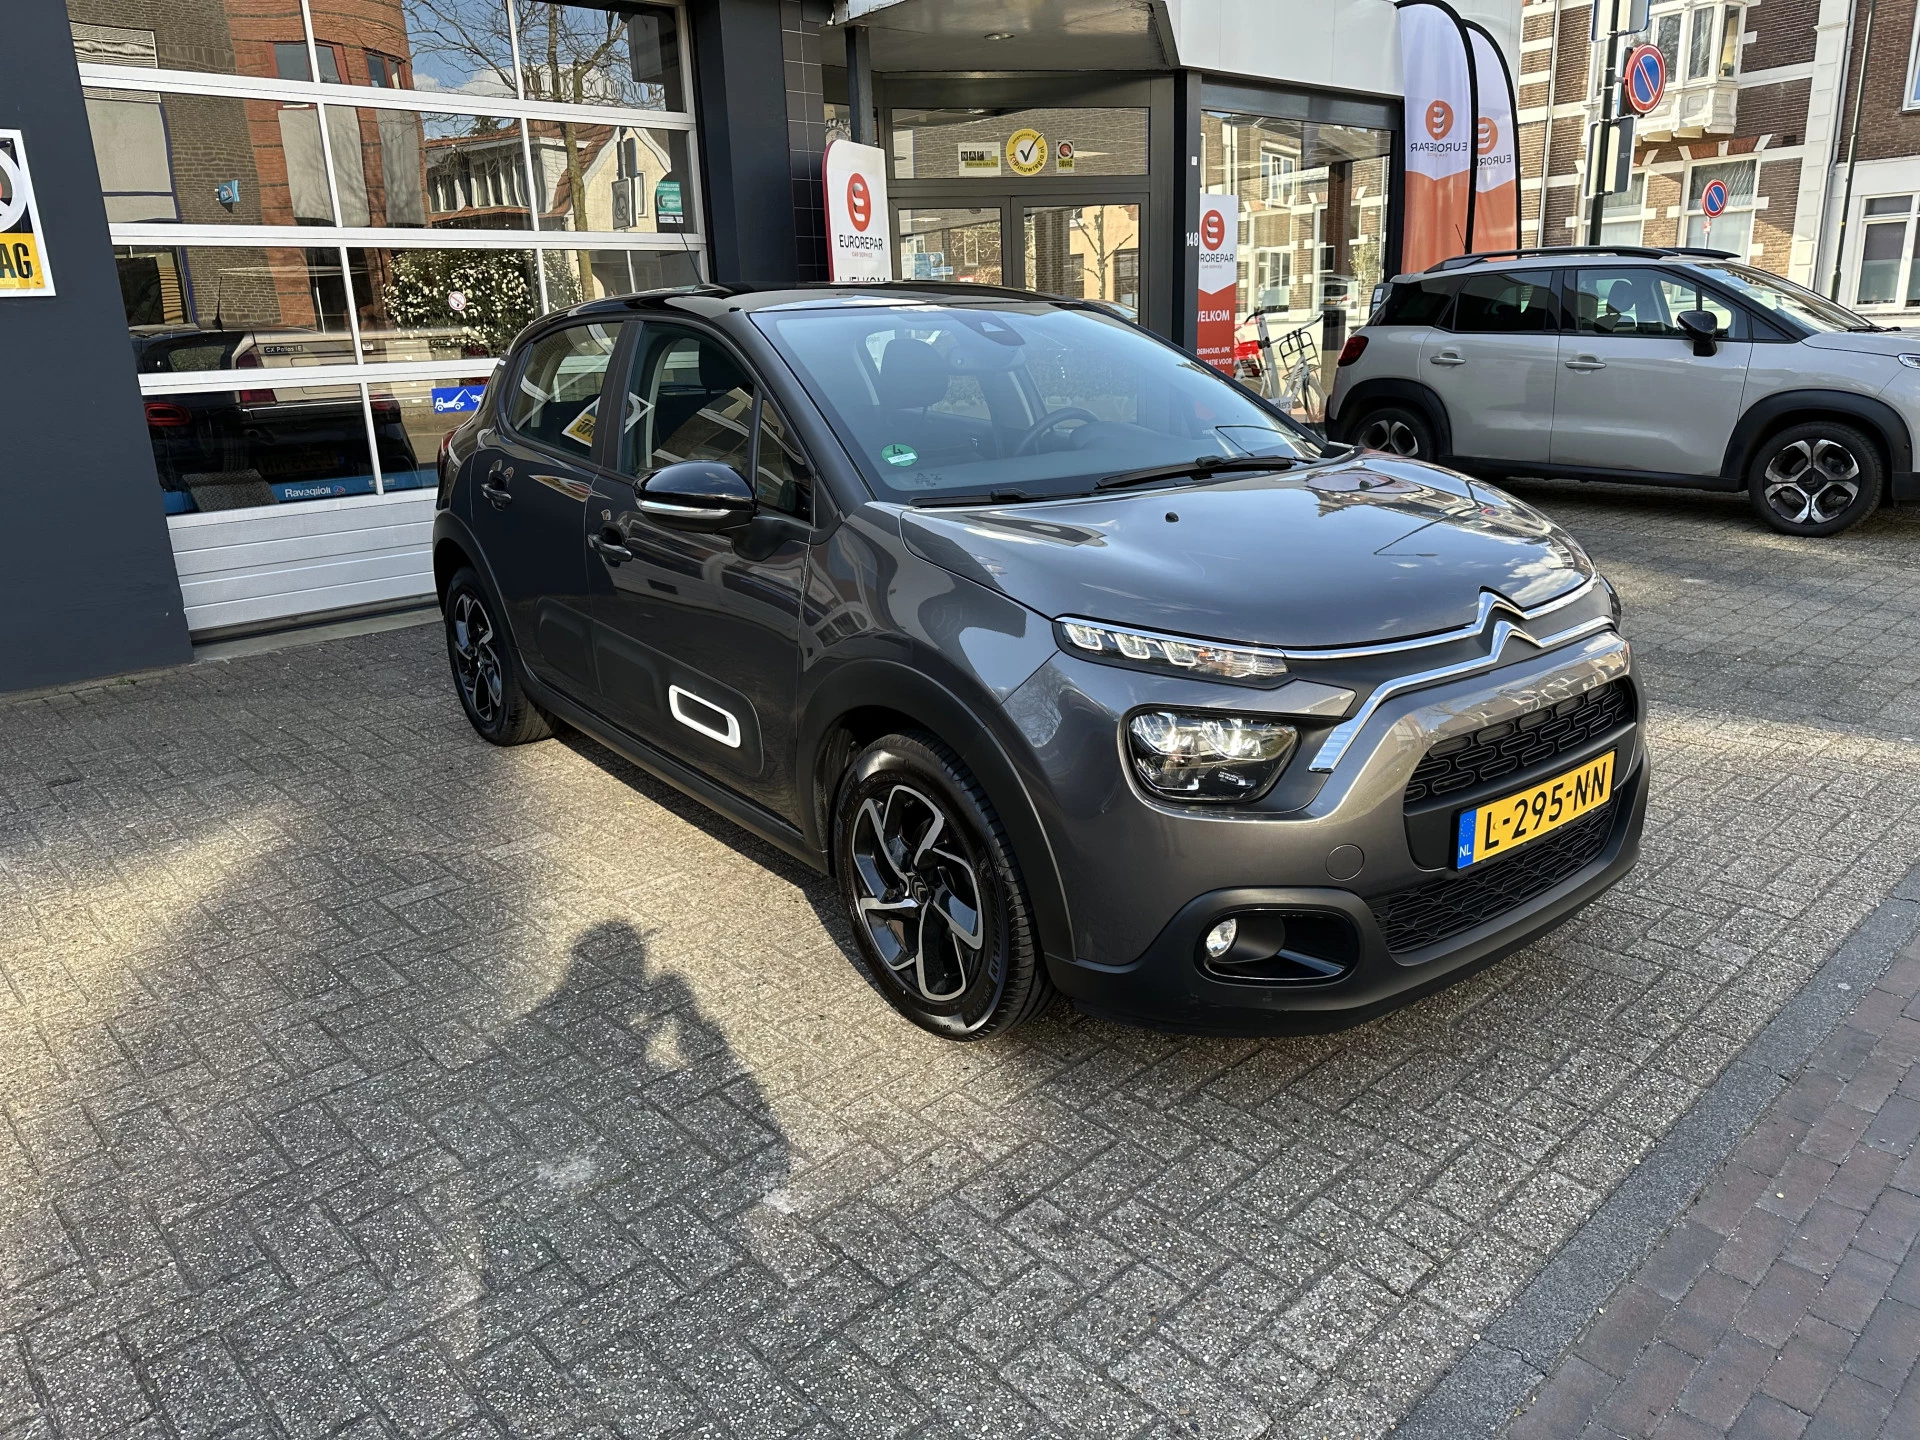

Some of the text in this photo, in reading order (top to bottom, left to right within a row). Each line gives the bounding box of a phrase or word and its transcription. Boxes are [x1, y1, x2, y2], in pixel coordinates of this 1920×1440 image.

[839, 235, 883, 250] EUROREPAR
[1186, 232, 1199, 247] 148
[1198, 310, 1230, 322] ELKOM
[1484, 761, 1607, 851] L-295-NN
[1459, 843, 1472, 858] NL
